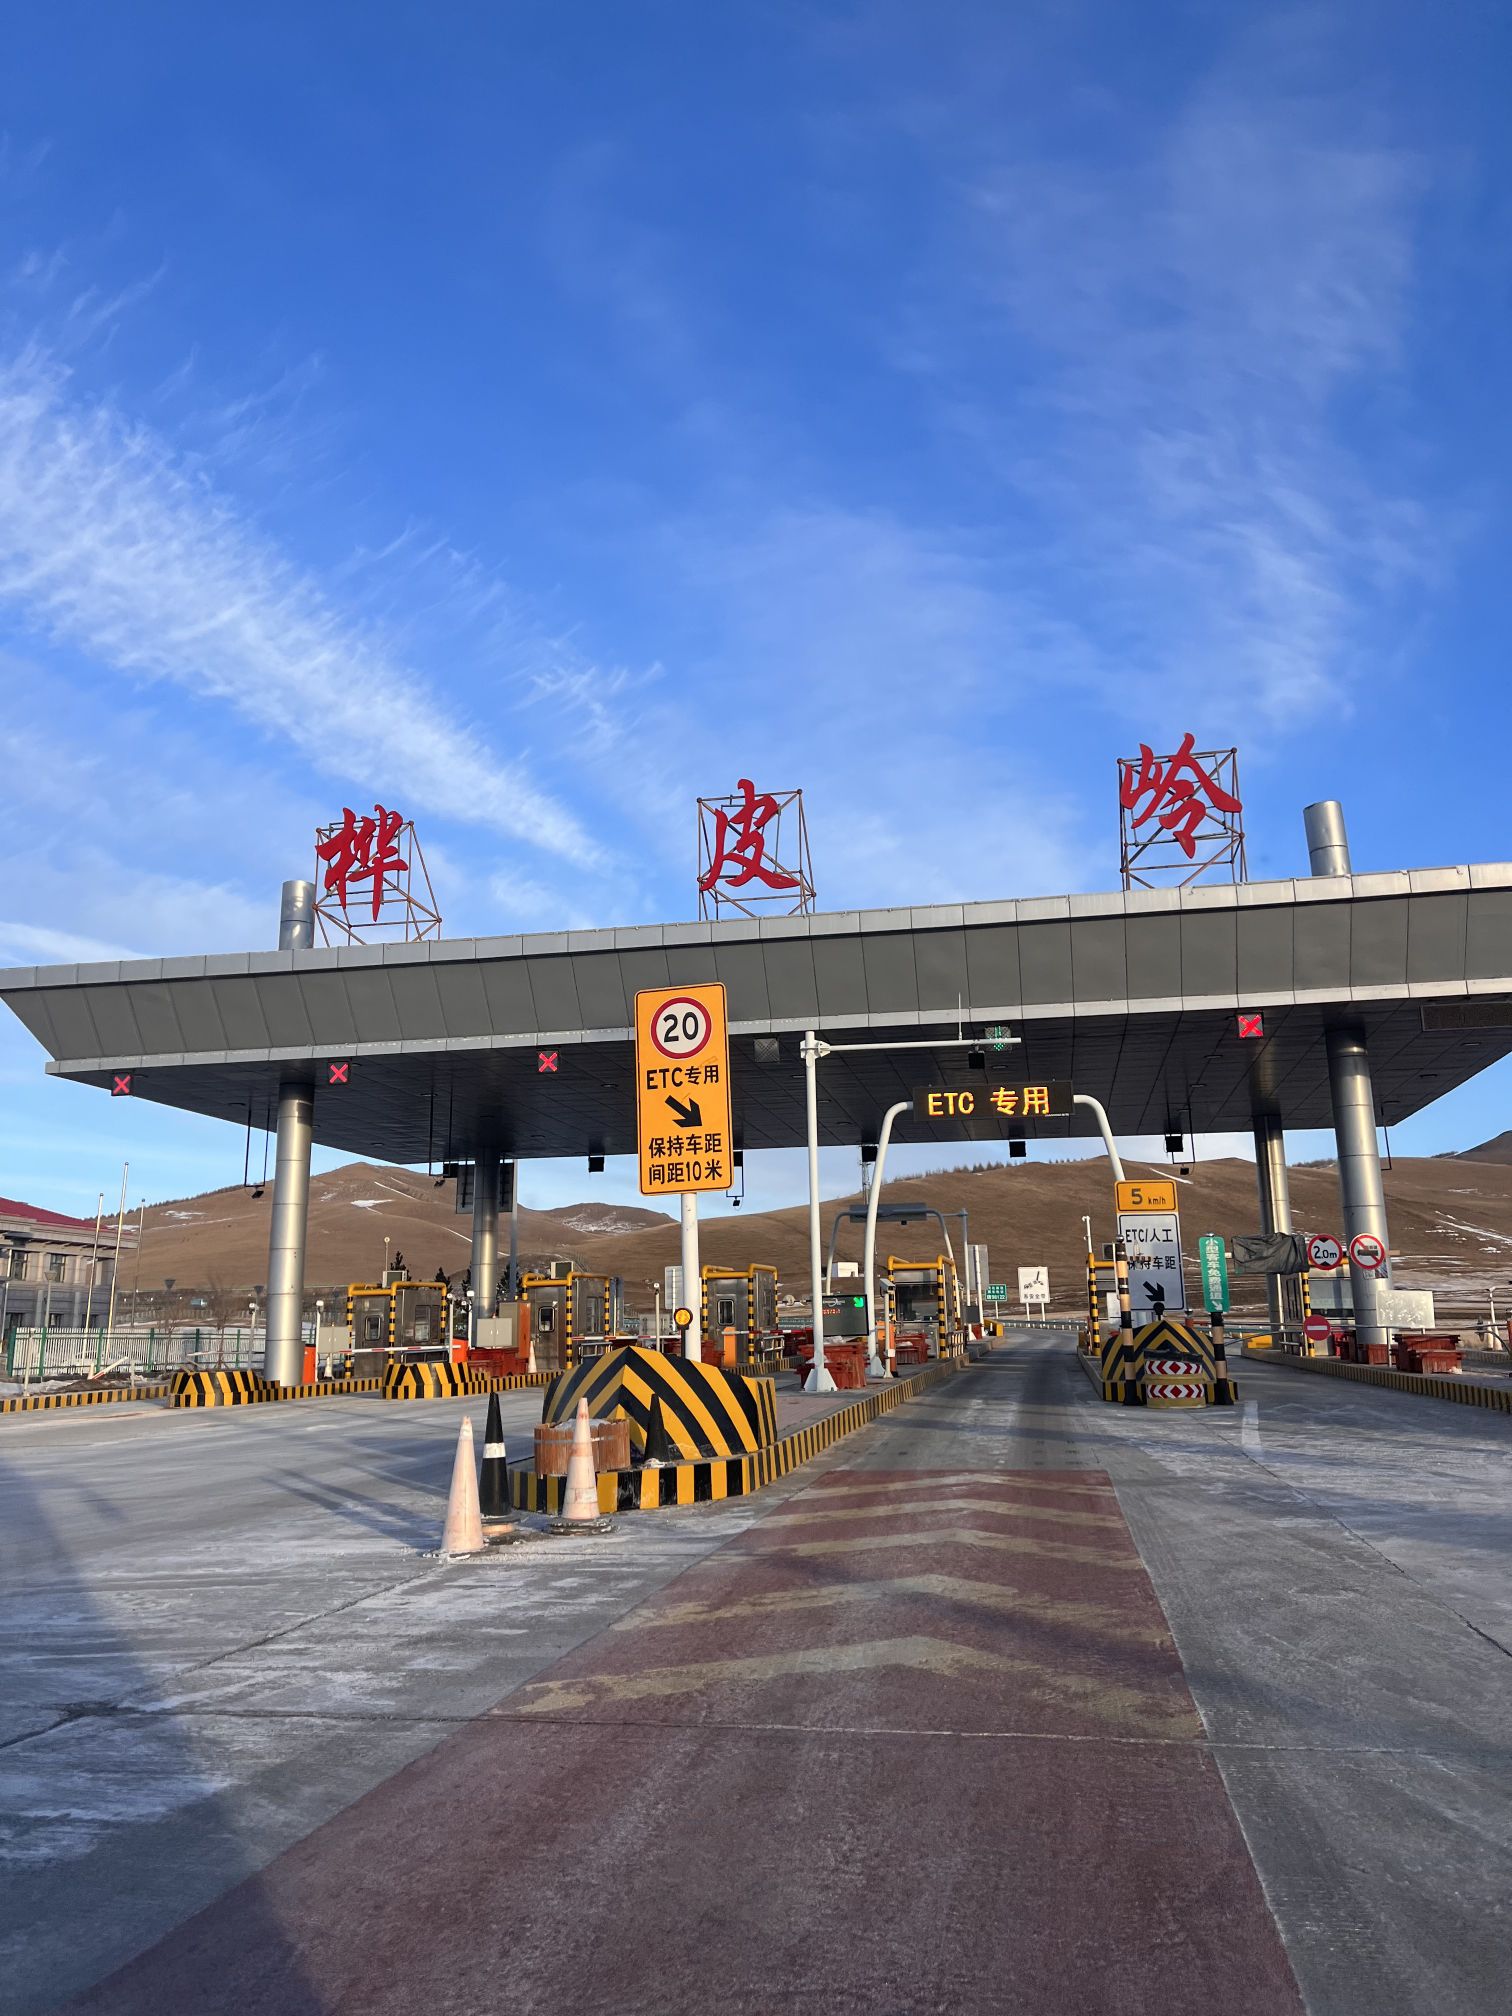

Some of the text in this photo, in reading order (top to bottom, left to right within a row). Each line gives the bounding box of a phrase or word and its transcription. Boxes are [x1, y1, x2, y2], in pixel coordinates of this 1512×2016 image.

[663, 1011, 699, 1043] 20
[646, 1064, 719, 1090] ETC专用
[927, 1086, 1050, 1116] ETC 专用
[648, 1132, 723, 1158] 保持车距
[649, 1158, 723, 1185] 间距10米
[1131, 1188, 1166, 1205] 5 km/h
[1125, 1228, 1174, 1243] ETC/人工
[1313, 1246, 1338, 1259] 2.0m
